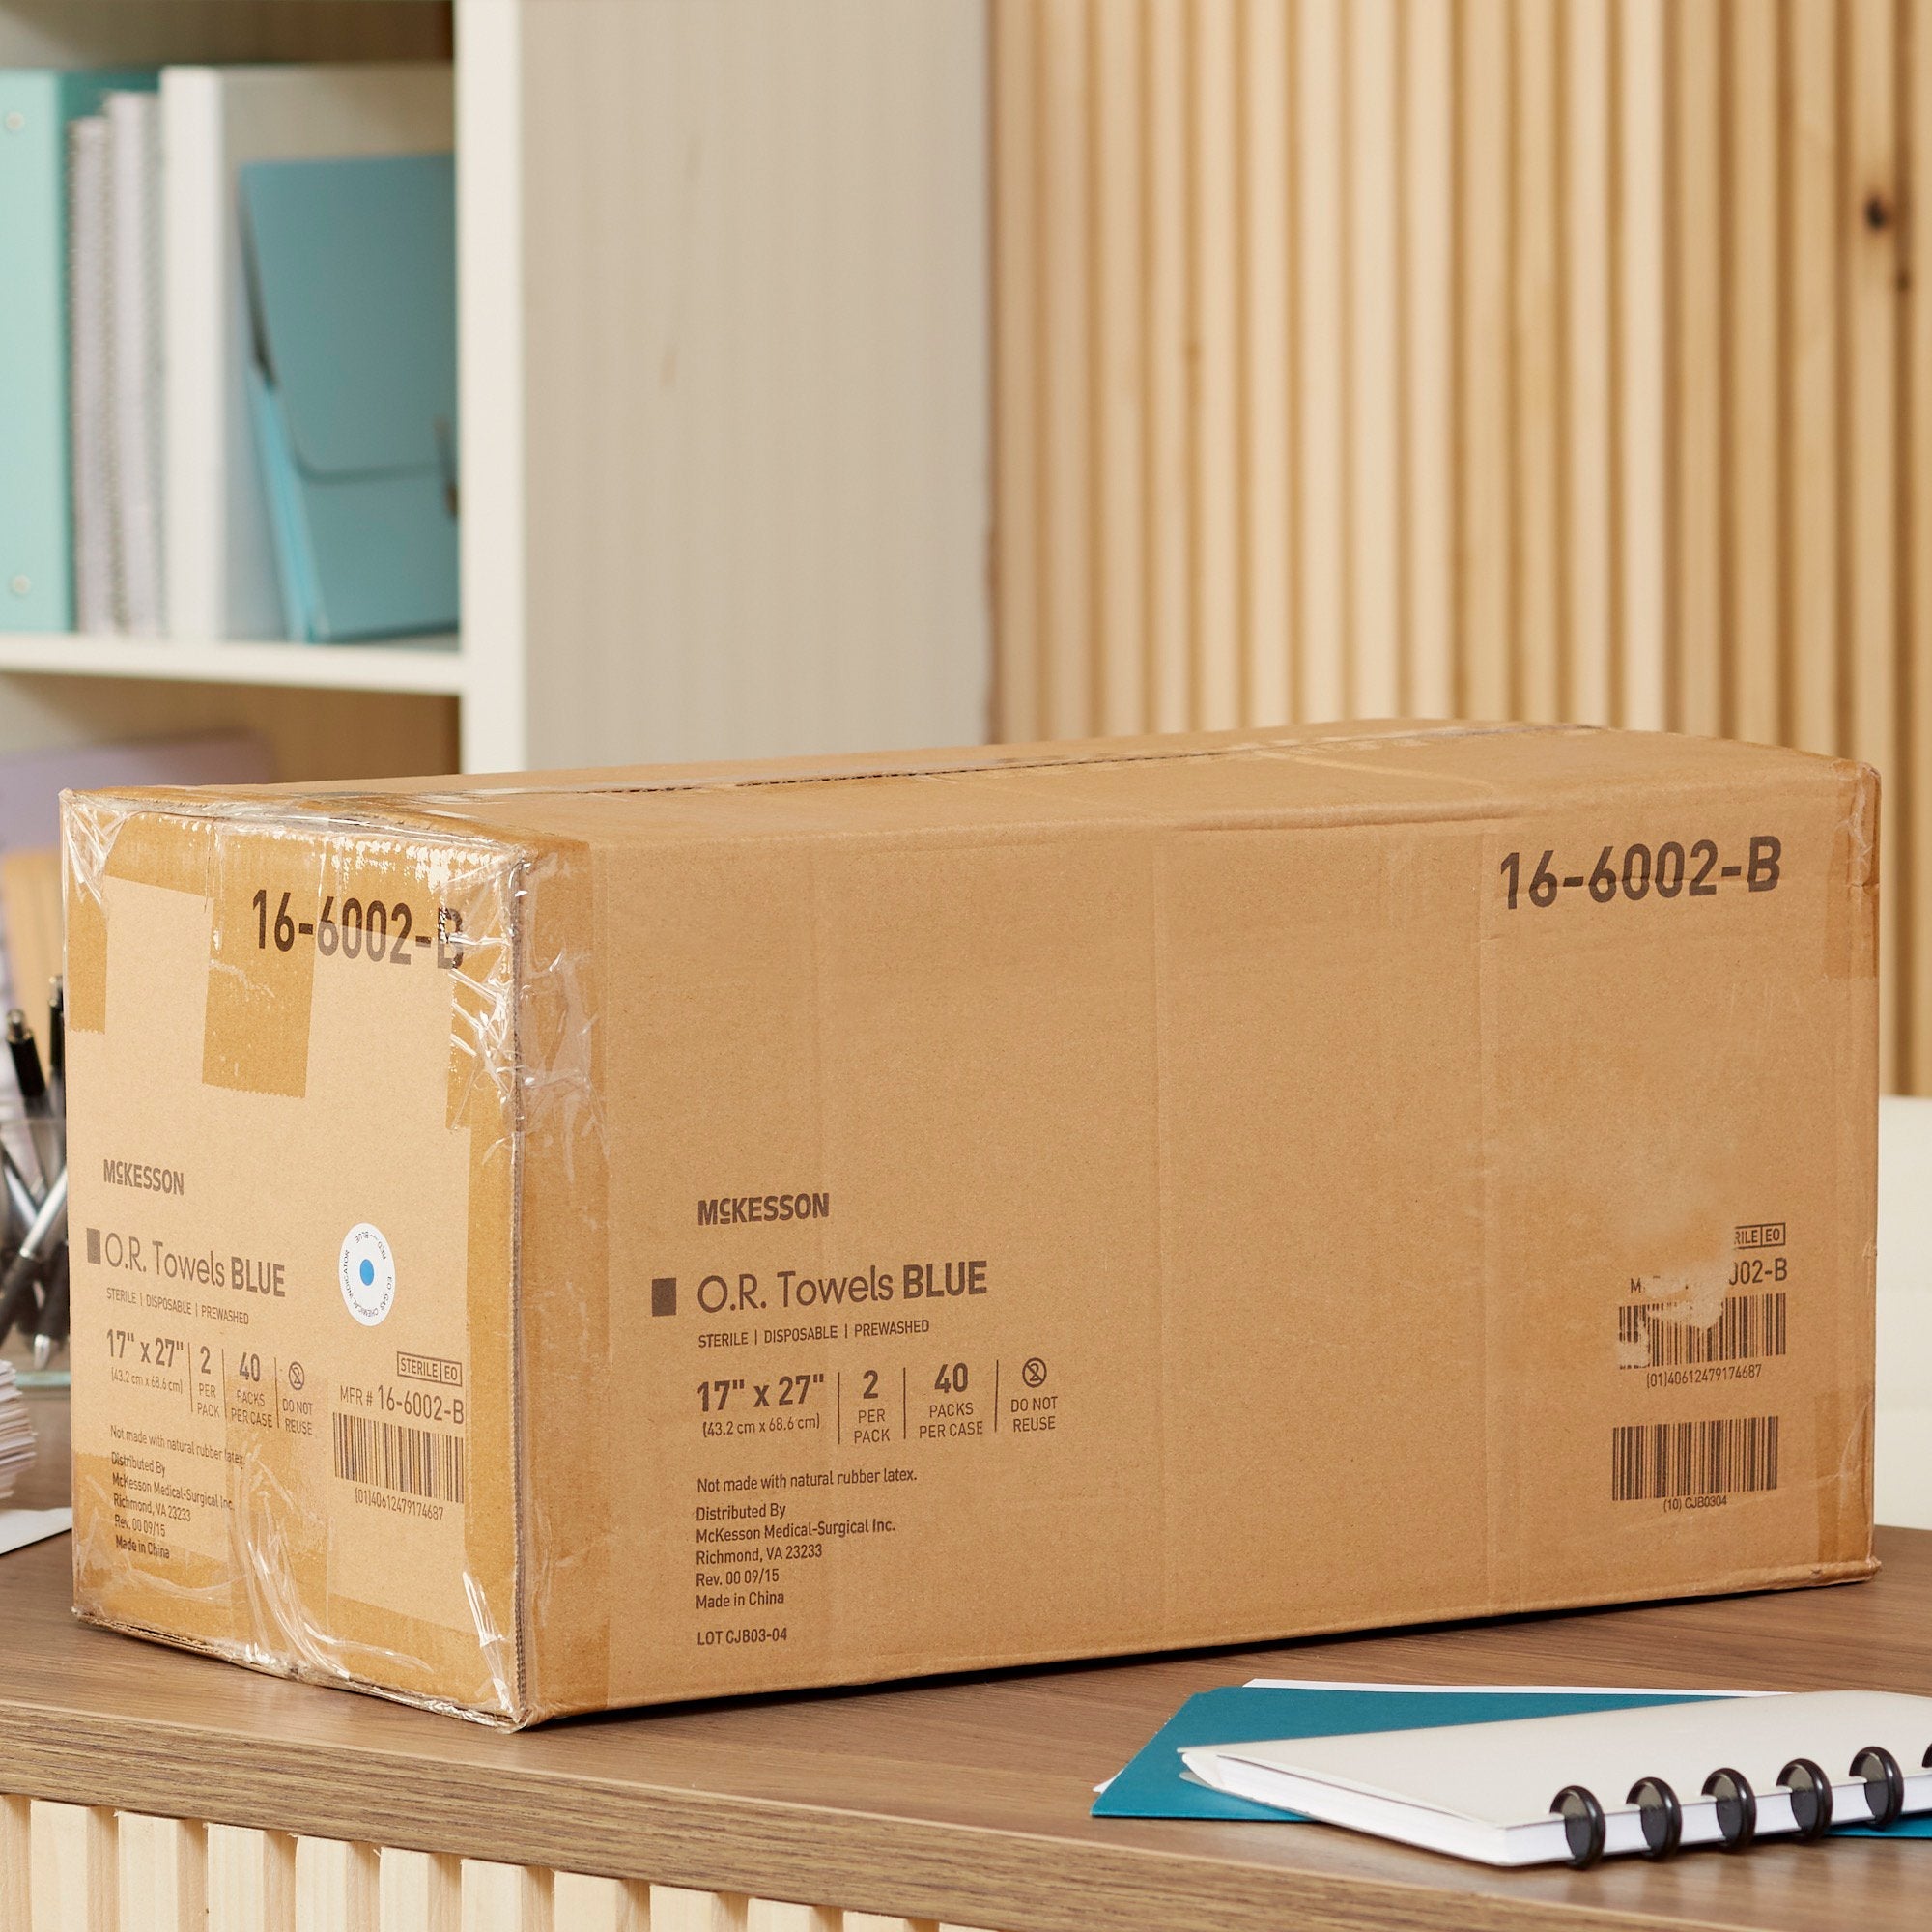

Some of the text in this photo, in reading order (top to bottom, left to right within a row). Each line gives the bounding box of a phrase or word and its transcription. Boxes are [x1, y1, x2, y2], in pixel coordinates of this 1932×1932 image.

[1500, 836, 1782, 909] 16-6002-B
[252, 889, 465, 969] 16-6002-B
[1765, 1228, 1780, 1242] EO
[105, 1232, 286, 1297] O.R. Towels BLUE
[697, 1260, 987, 1314] O.R. Towels BLUE
[106, 1287, 249, 1324] STERILE DISPOSABLE PREWASHED
[697, 1319, 929, 1349] STERILE DISPOSABLE PREWASHED
[106, 1328, 184, 1367] 17" x 27"
[200, 1345, 211, 1375] 2
[239, 1351, 261, 1382] 40
[400, 1357, 439, 1378] STERILE
[444, 1365, 458, 1381] EO
[862, 1369, 879, 1400] 2
[934, 1362, 969, 1393] 40
[1646, 1363, 1762, 1389] (01)40612479174687
[198, 1382, 216, 1398] PER
[237, 1389, 265, 1406] PACKS
[697, 1373, 824, 1412] 17" x 27"
[197, 1402, 220, 1418] PACK
[282, 1398, 313, 1416] DO NOT
[340, 1384, 464, 1425] MFR # 16-6002-B
[858, 1408, 886, 1424] PER
[929, 1402, 974, 1418] PACKS
[1010, 1396, 1058, 1413] DO NOT
[231, 1407, 273, 1429] PER CASE
[285, 1418, 313, 1435] REUSE
[702, 1412, 820, 1438] (43.2 cm x 68.6 cm)
[919, 1420, 983, 1439] PER CASE
[1013, 1415, 1056, 1433] REUSE
[109, 1425, 125, 1439] Not
[126, 1430, 147, 1444] made
[149, 1434, 165, 1447] with
[167, 1439, 194, 1455] natural
[196, 1445, 222, 1461] rubber
[854, 1428, 890, 1444] PACK
[111, 1451, 166, 1478] Distributed By
[112, 1472, 152, 1493] McKesson
[154, 1481, 219, 1508] Medical-Surgical
[697, 1467, 918, 1493] Not made with natural rubber latex.
[113, 1493, 191, 1522] Richmond, VA 23233
[696, 1502, 786, 1521] Distributed By
[1663, 1495, 1727, 1513] (10) CJB0304
[115, 1514, 166, 1537] Rev. 00 09/15
[696, 1518, 896, 1544] McKesson Medical-Surgical Inc.
[115, 1534, 170, 1559] Made in China
[696, 1543, 822, 1565] Richmond, VA 23233
[696, 1567, 780, 1587] Rev. 00 09/15
[696, 1590, 784, 1609] Made in China
[697, 1627, 787, 1646] LOT CJB03-04
